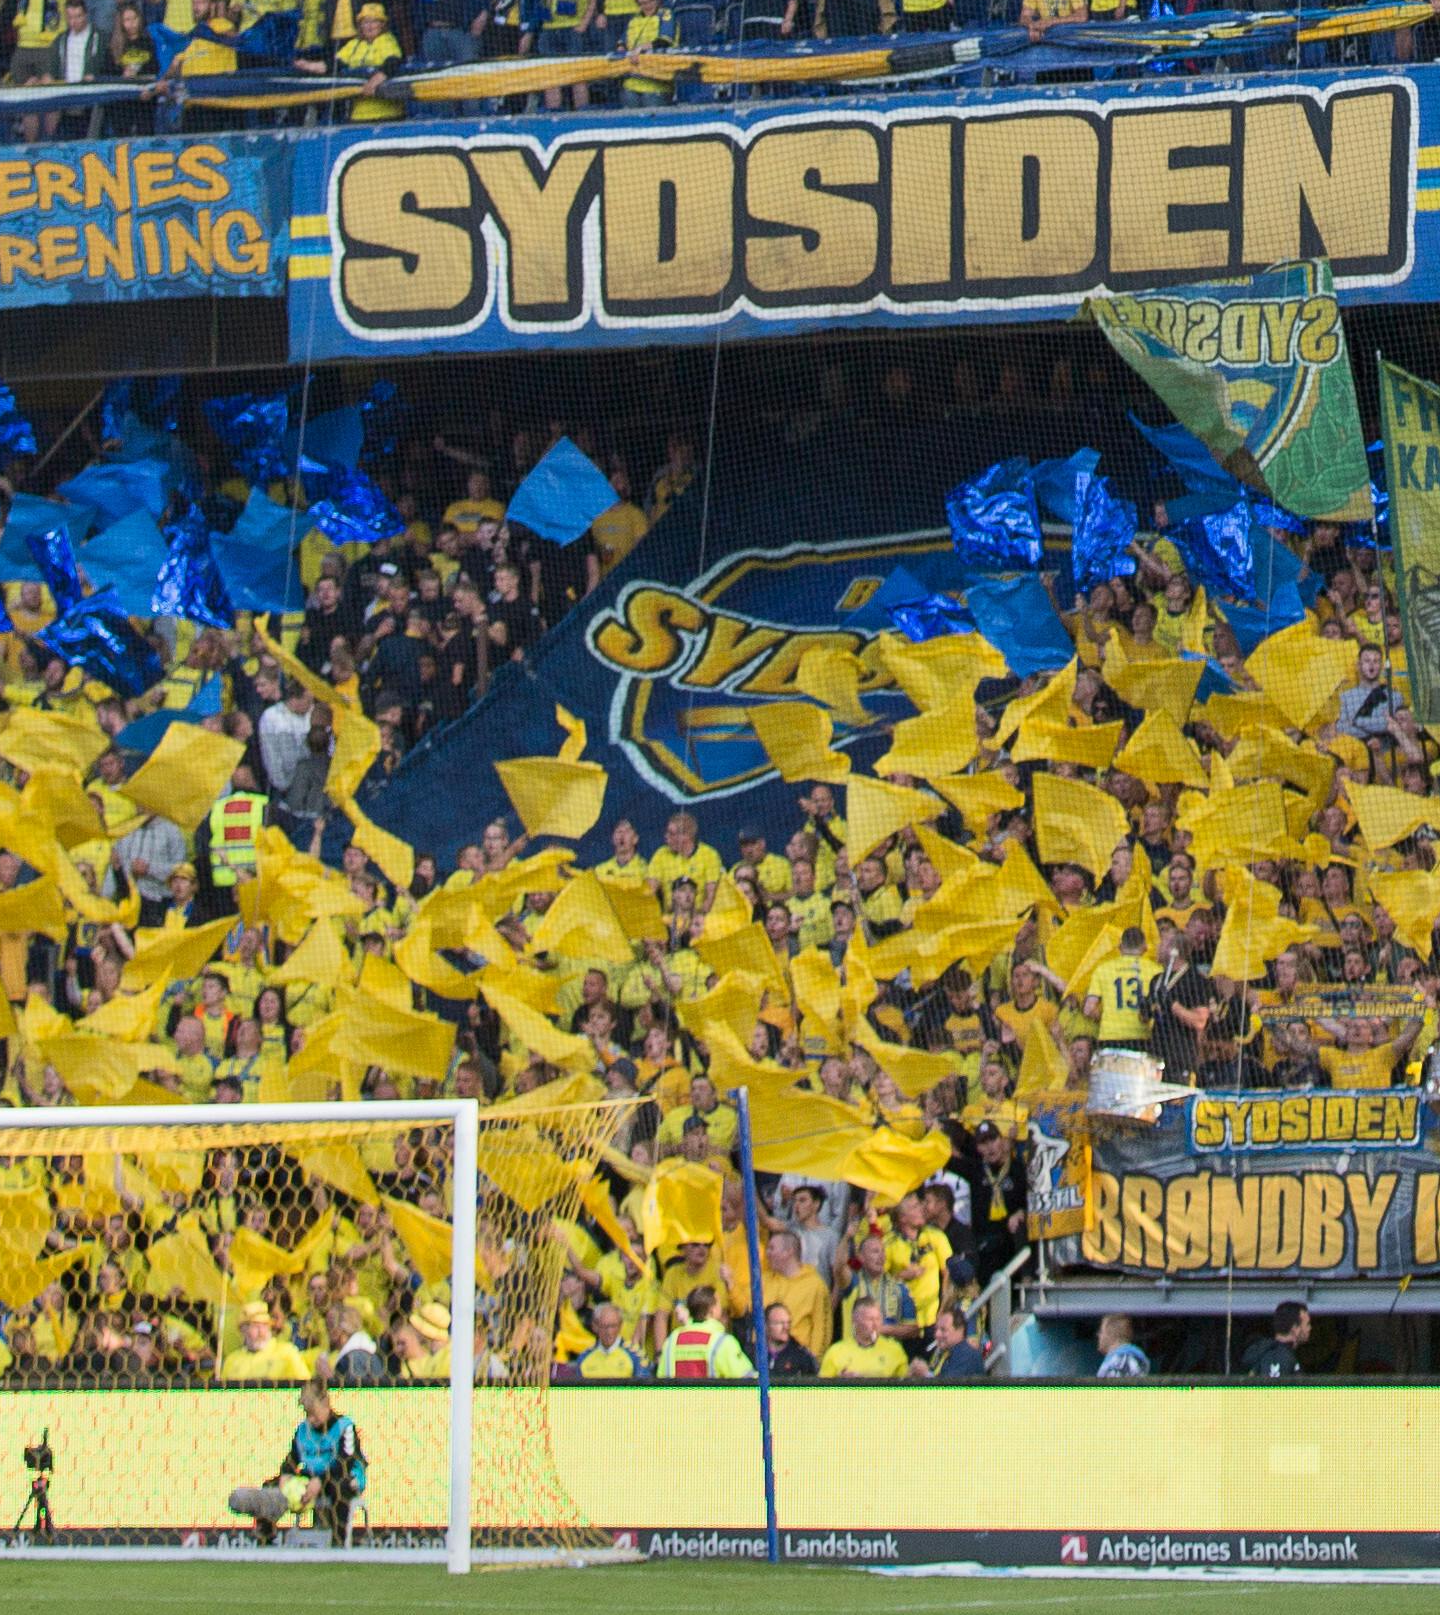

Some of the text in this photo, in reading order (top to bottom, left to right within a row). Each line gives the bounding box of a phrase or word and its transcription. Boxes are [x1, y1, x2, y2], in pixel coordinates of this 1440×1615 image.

[332, 82, 1410, 326] SYDSIDEN
[1114, 977, 1143, 1009] 13
[1193, 1095, 1421, 1148] SYDSIDEN
[1084, 1169, 1400, 1272] BRØNDBY
[785, 1533, 899, 1559] Landsbank
[1098, 1536, 1231, 1565] Arbejdernes
[1240, 1535, 1359, 1562] Landsbank
